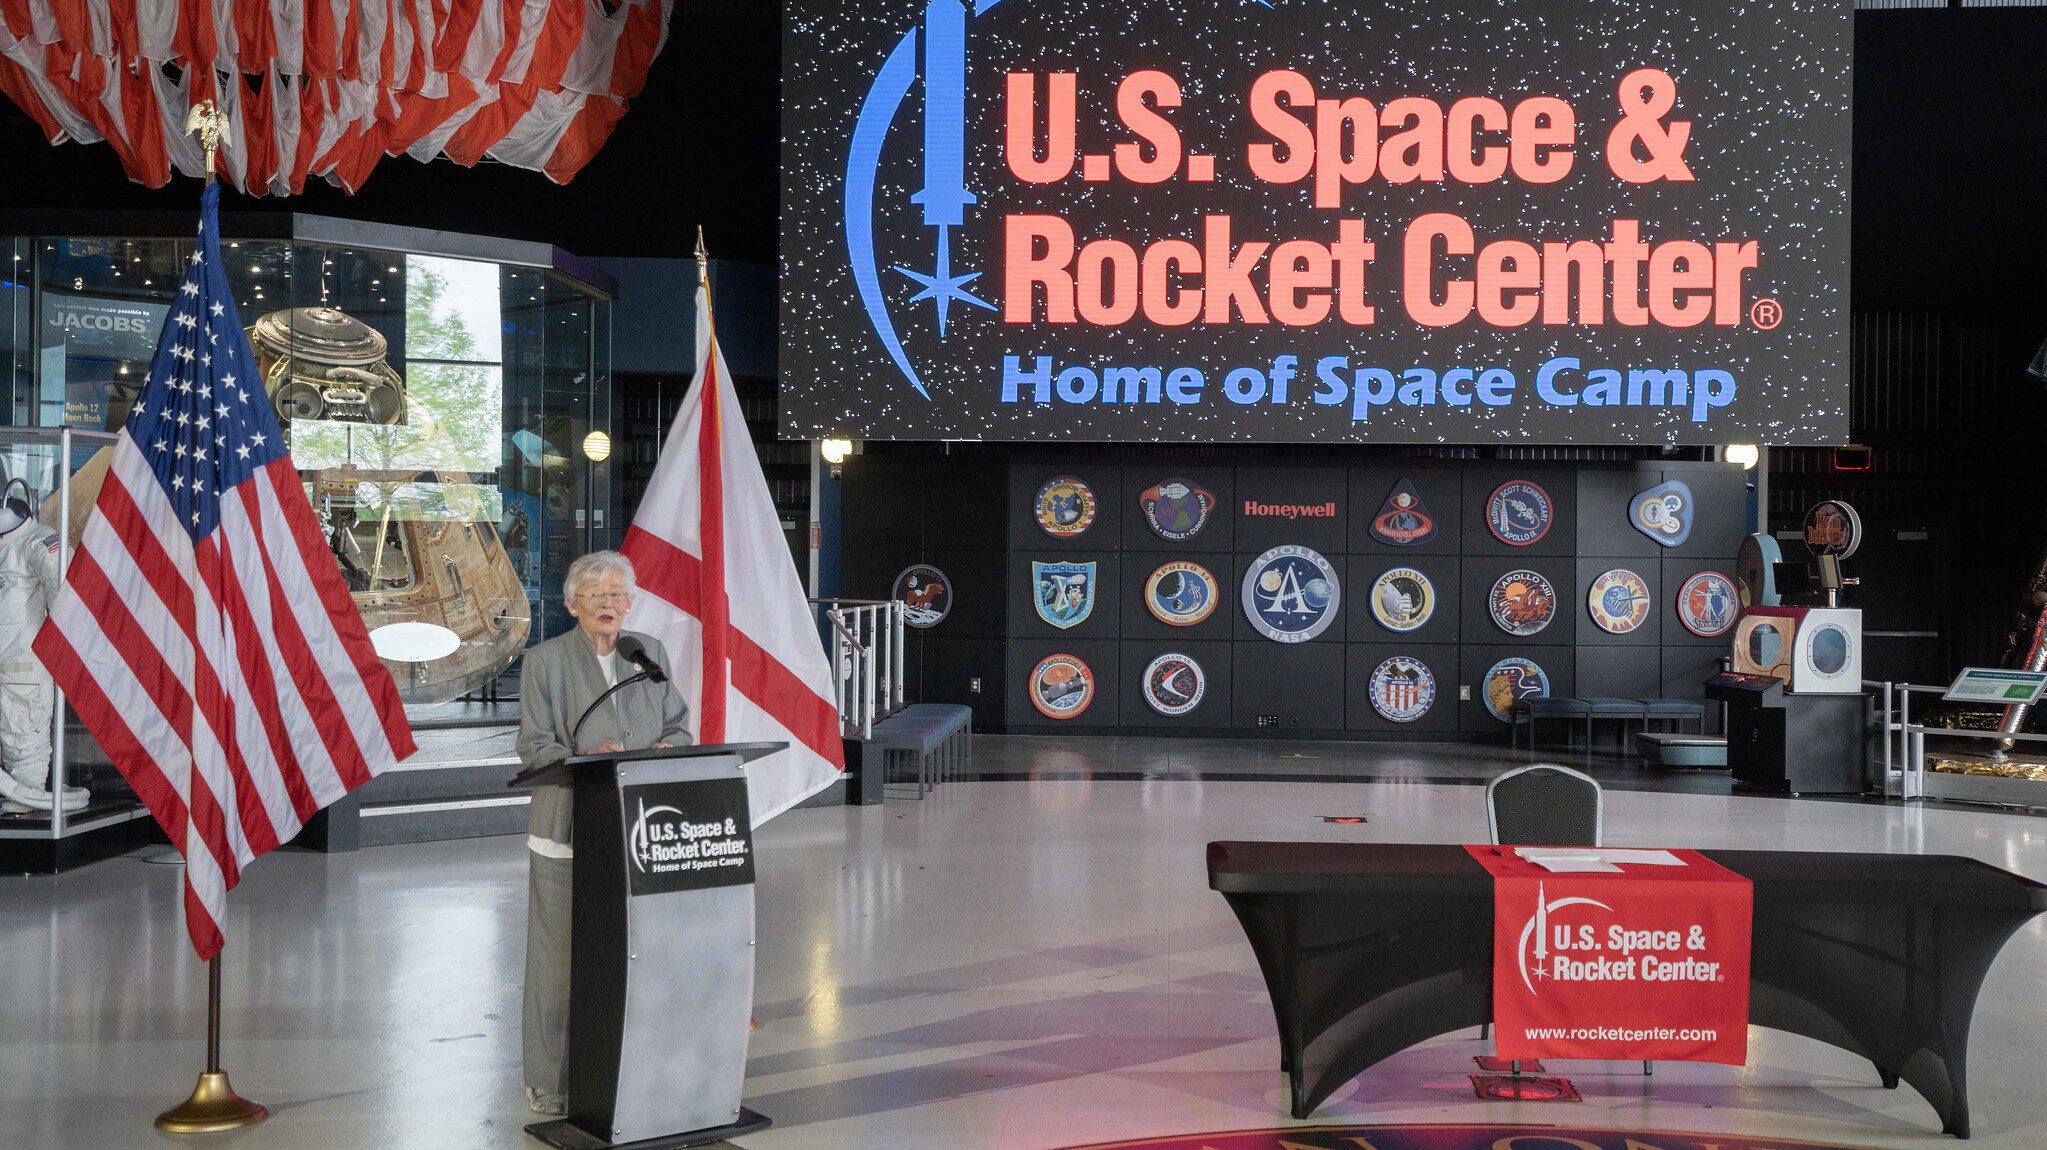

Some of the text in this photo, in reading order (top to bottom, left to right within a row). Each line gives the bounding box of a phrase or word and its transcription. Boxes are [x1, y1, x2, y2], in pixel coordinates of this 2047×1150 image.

[1006, 68, 1695, 208] U.S. Space &
[1004, 214, 1375, 326] Rocket
[1403, 213, 1757, 327] Center
[118, 308, 142, 316] possible
[142, 308, 150, 316] by
[48, 312, 146, 334] JACOBS
[1001, 354, 1737, 422] Home of Space Camp
[66, 402, 99, 413] Apollo 12
[83, 413, 102, 423] Rock
[1052, 484, 1078, 492] GRISSOM
[1500, 485, 1520, 498] SCOTT
[1244, 501, 1336, 519] Honeywell
[1048, 520, 1078, 532] APOLLO
[1162, 530, 1186, 539] EISELE
[1504, 530, 1538, 541] APOLLO IX
[1256, 545, 1330, 570] APOLLO
[912, 569, 936, 578] APOLLO
[1156, 564, 1198, 578] APOLLO
[1379, 570, 1412, 590] APOLLO
[1501, 574, 1552, 596] APOLLO XIII
[1268, 630, 1312, 643] NASA
[1154, 656, 1182, 666] APOLLO
[1146, 682, 1203, 713] SCOTT WORDEN IRWIN
[650, 817, 737, 842] U.S. Space &
[651, 838, 745, 862] Rocket Center
[652, 856, 744, 873] Home of Space Camp
[1554, 924, 1706, 956] U.S. Space &
[1553, 955, 1636, 981] Rocket
[1641, 955, 1720, 982] Center
[1525, 1026, 1717, 1042] www.rocketcenter.com
